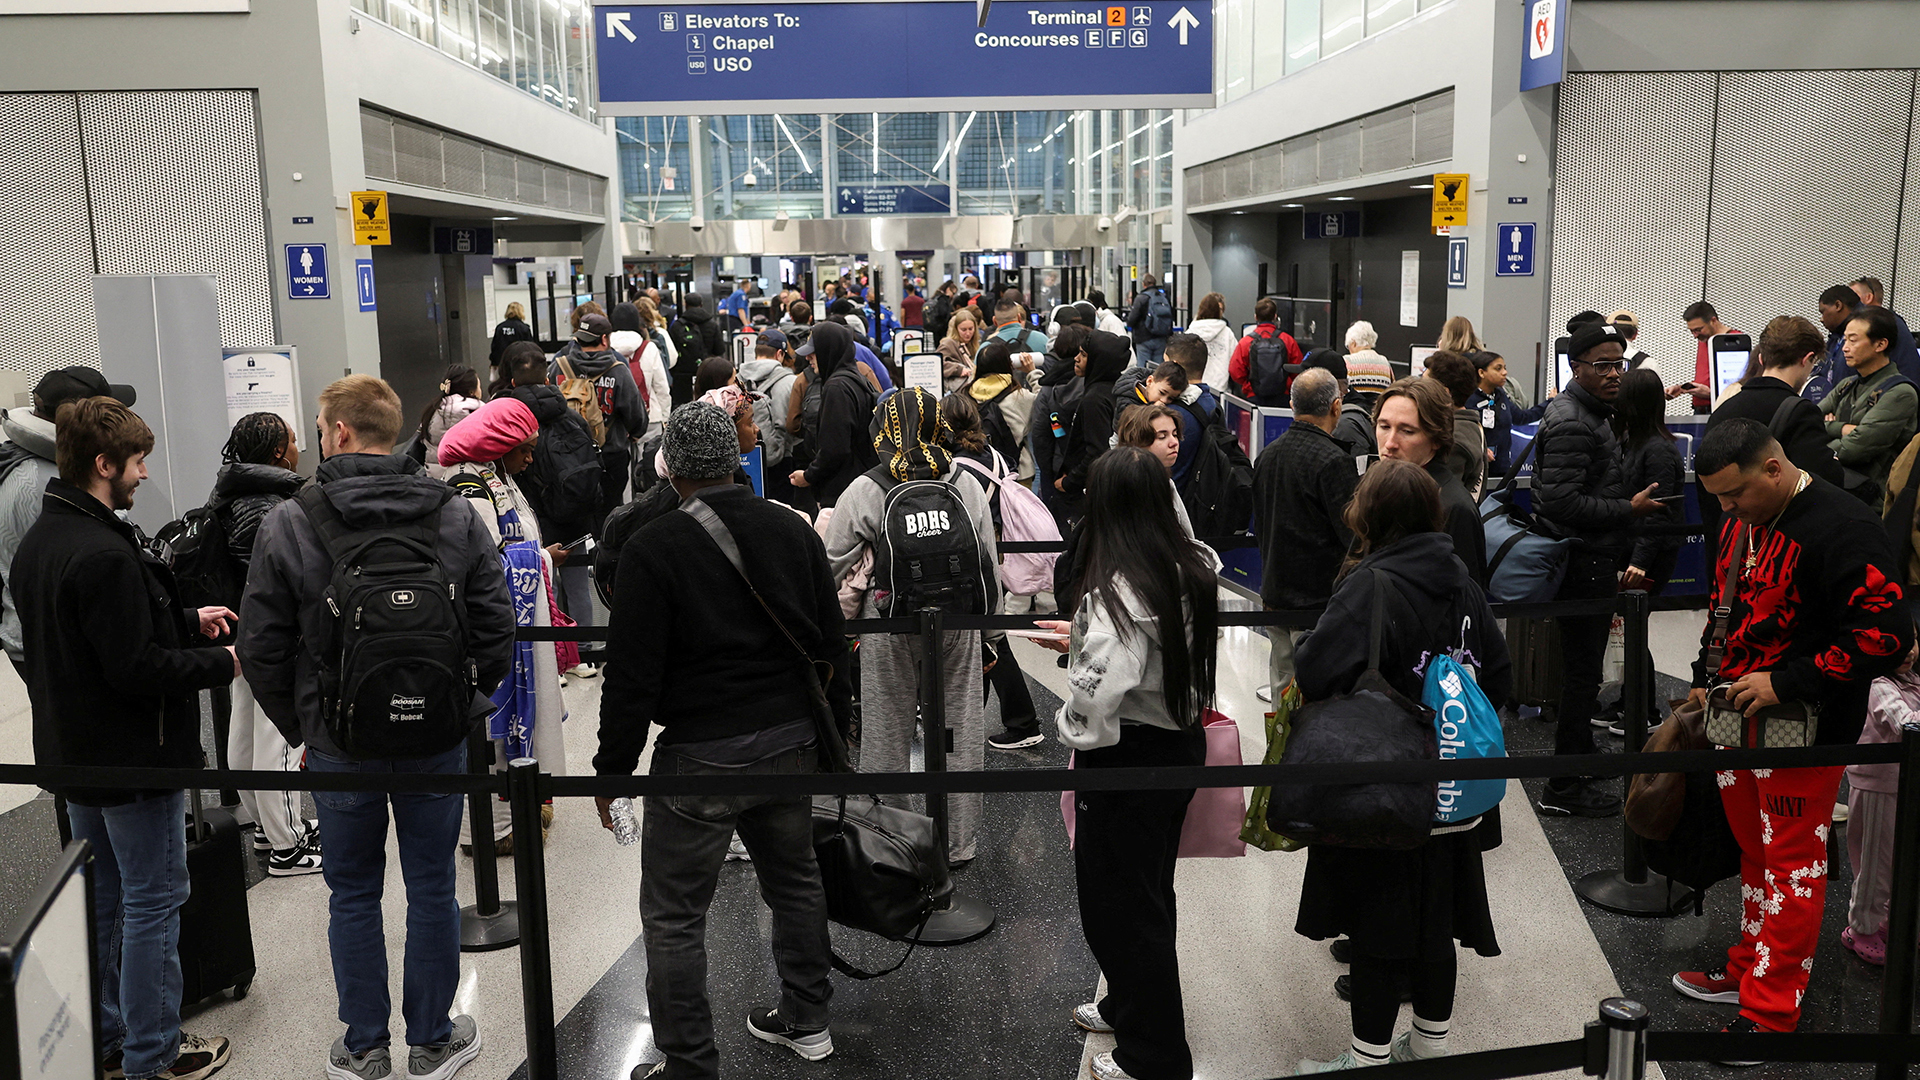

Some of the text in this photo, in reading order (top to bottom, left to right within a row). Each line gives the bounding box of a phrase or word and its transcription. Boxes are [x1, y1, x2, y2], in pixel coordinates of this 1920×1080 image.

[1028, 9, 1121, 25] Terminal 2
[1537, 2, 1551, 16] AED
[685, 13, 800, 29] Elevators To:
[712, 35, 774, 53] Chapel
[974, 30, 1145, 48] Concourses E F G
[689, 61, 705, 69] USO
[713, 56, 752, 72] USO
[1507, 254, 1523, 262] MEN
[293, 276, 323, 284] WOMEN
[502, 327, 515, 335] TSA
[905, 510, 950, 535] BDHS
[916, 527, 942, 538] cheer
[1766, 793, 1806, 817] SAINT
